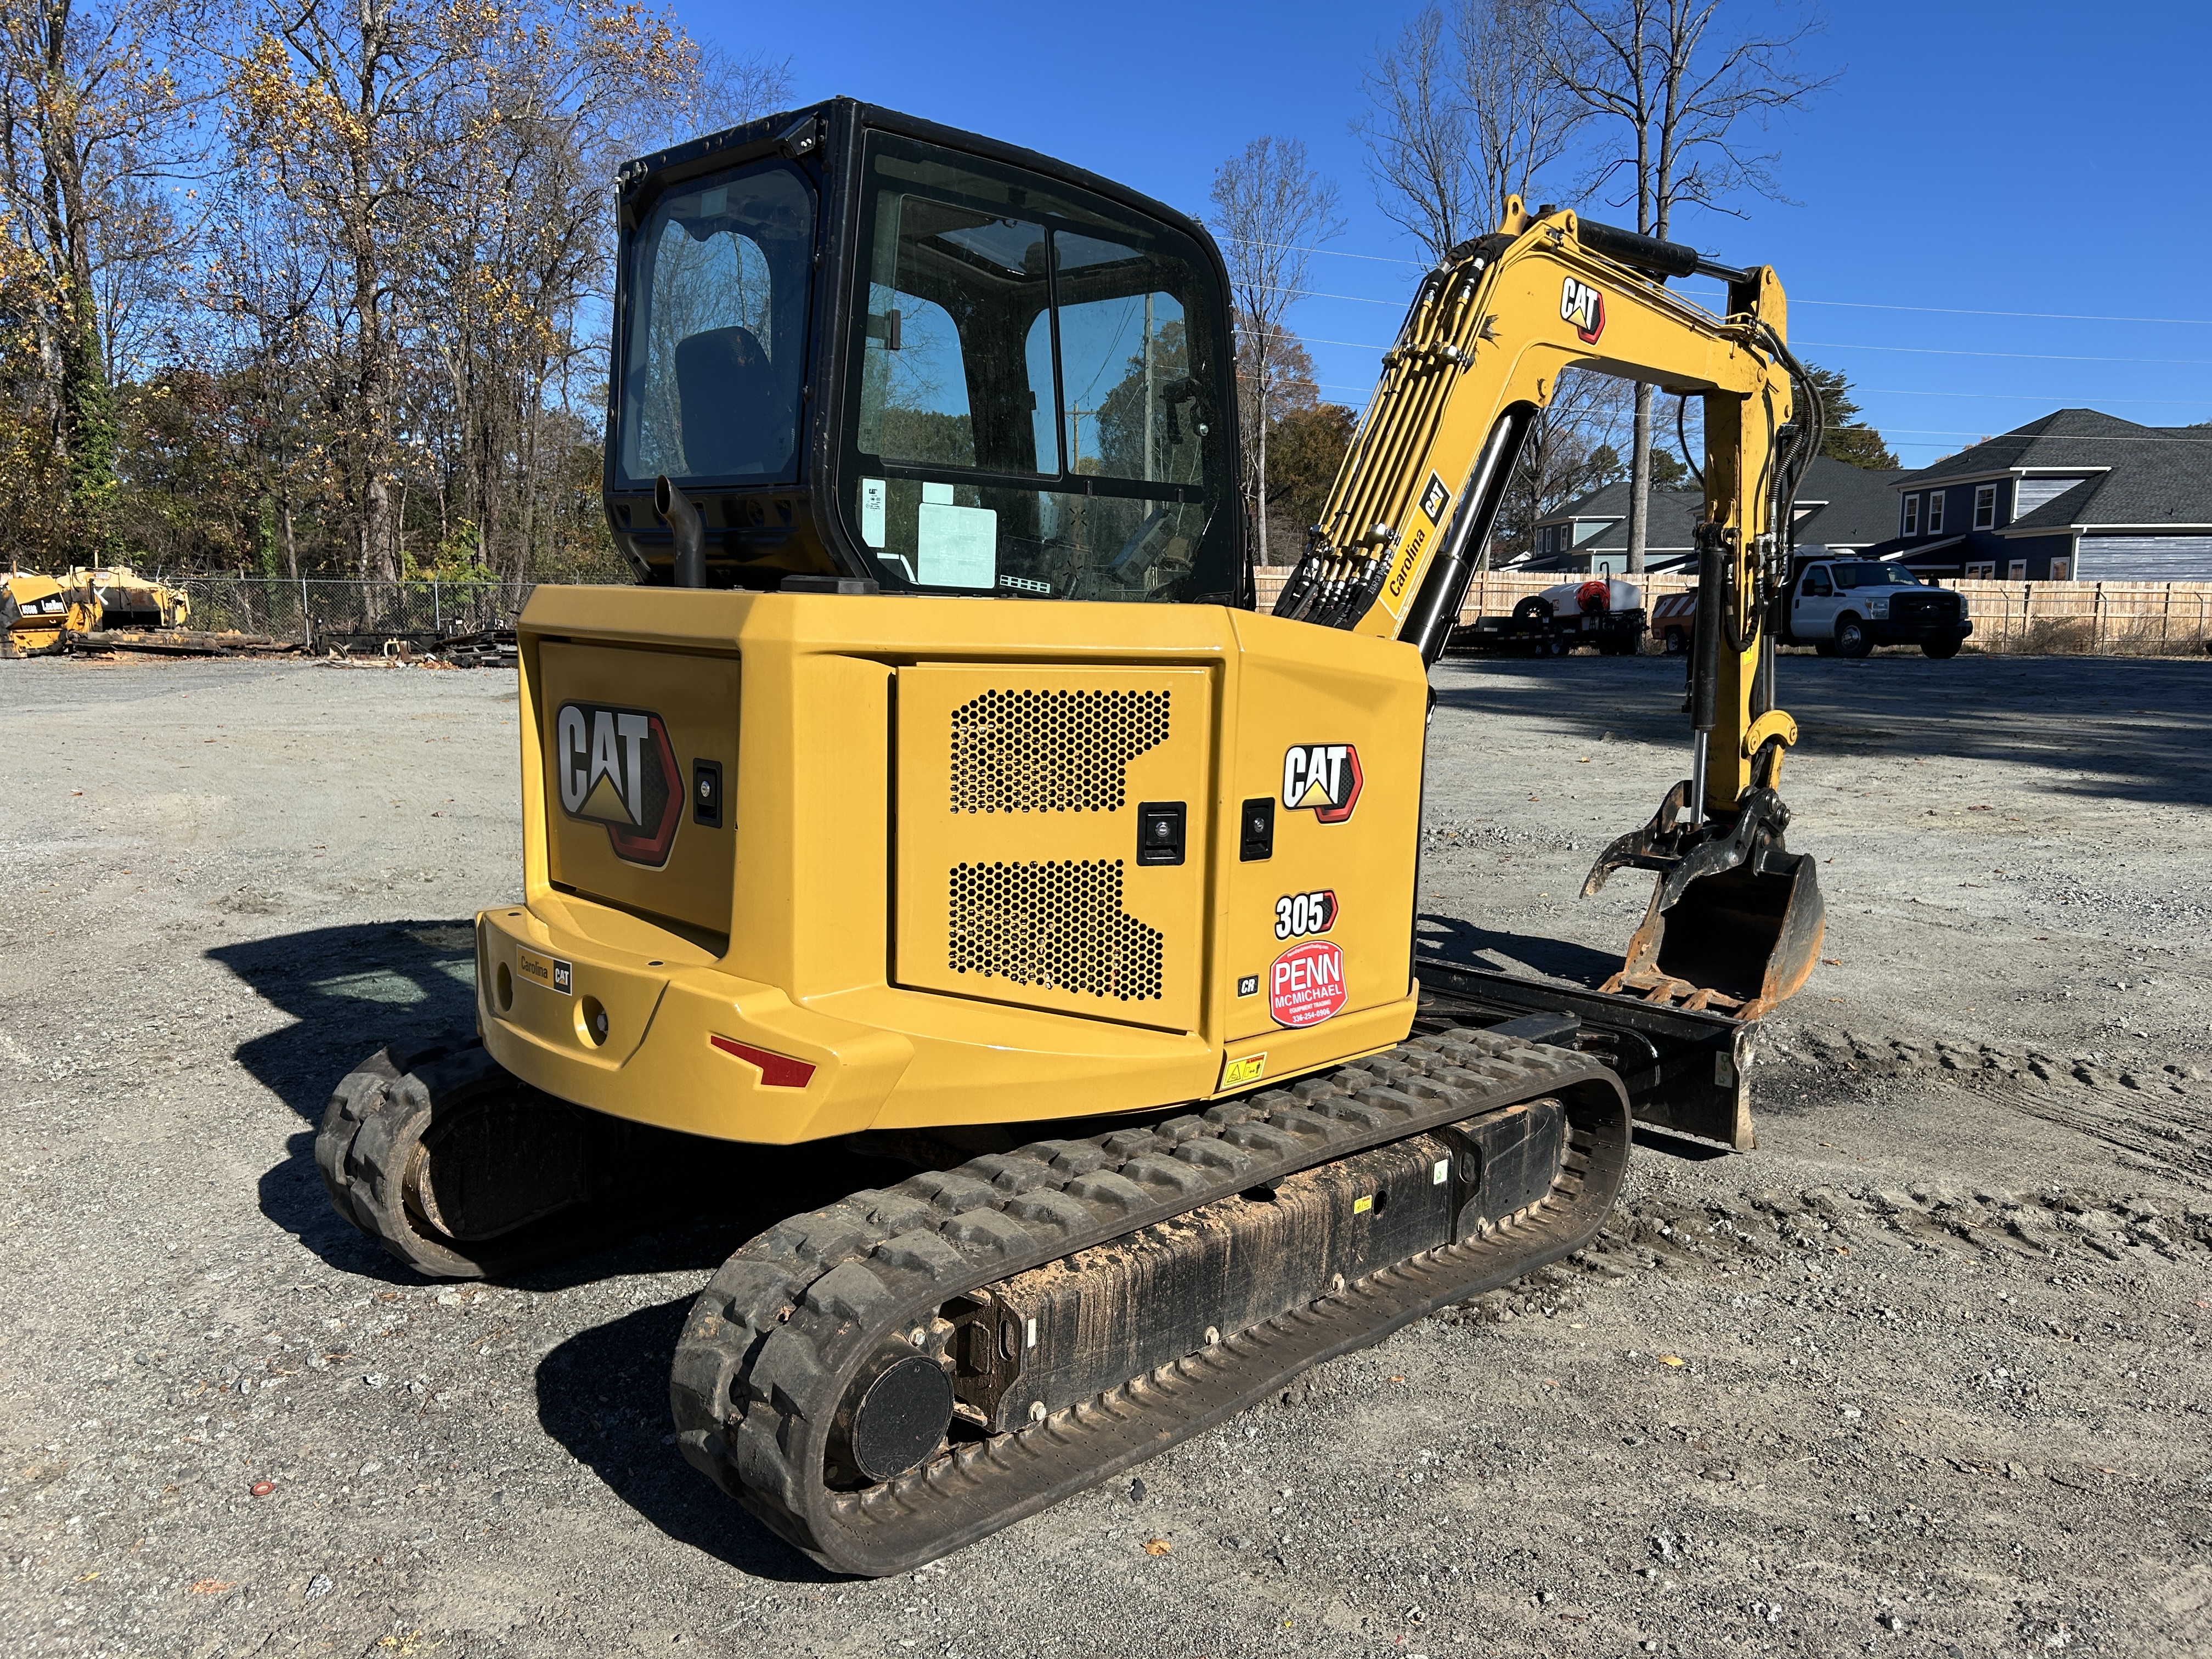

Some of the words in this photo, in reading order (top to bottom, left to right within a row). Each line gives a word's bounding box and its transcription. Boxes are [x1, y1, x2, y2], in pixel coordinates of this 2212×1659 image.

[1561, 277, 1598, 330] CAT
[1389, 528, 1425, 597] Carolina
[1425, 482, 1444, 518] CAT
[558, 706, 648, 826] CAT
[1283, 746, 1347, 808] CAT
[1276, 893, 1324, 938] 305
[521, 956, 548, 979] Carolina
[555, 968, 569, 986] CAT
[1241, 979, 1255, 994] CR
[1275, 951, 1340, 995] PENN
[1275, 984, 1342, 1008] MCMICHAEL
[1289, 1003, 1313, 1014] EQUIPMENT
[1313, 999, 1331, 1008] TRADING
[1292, 1008, 1330, 1023] 336-254-0906
